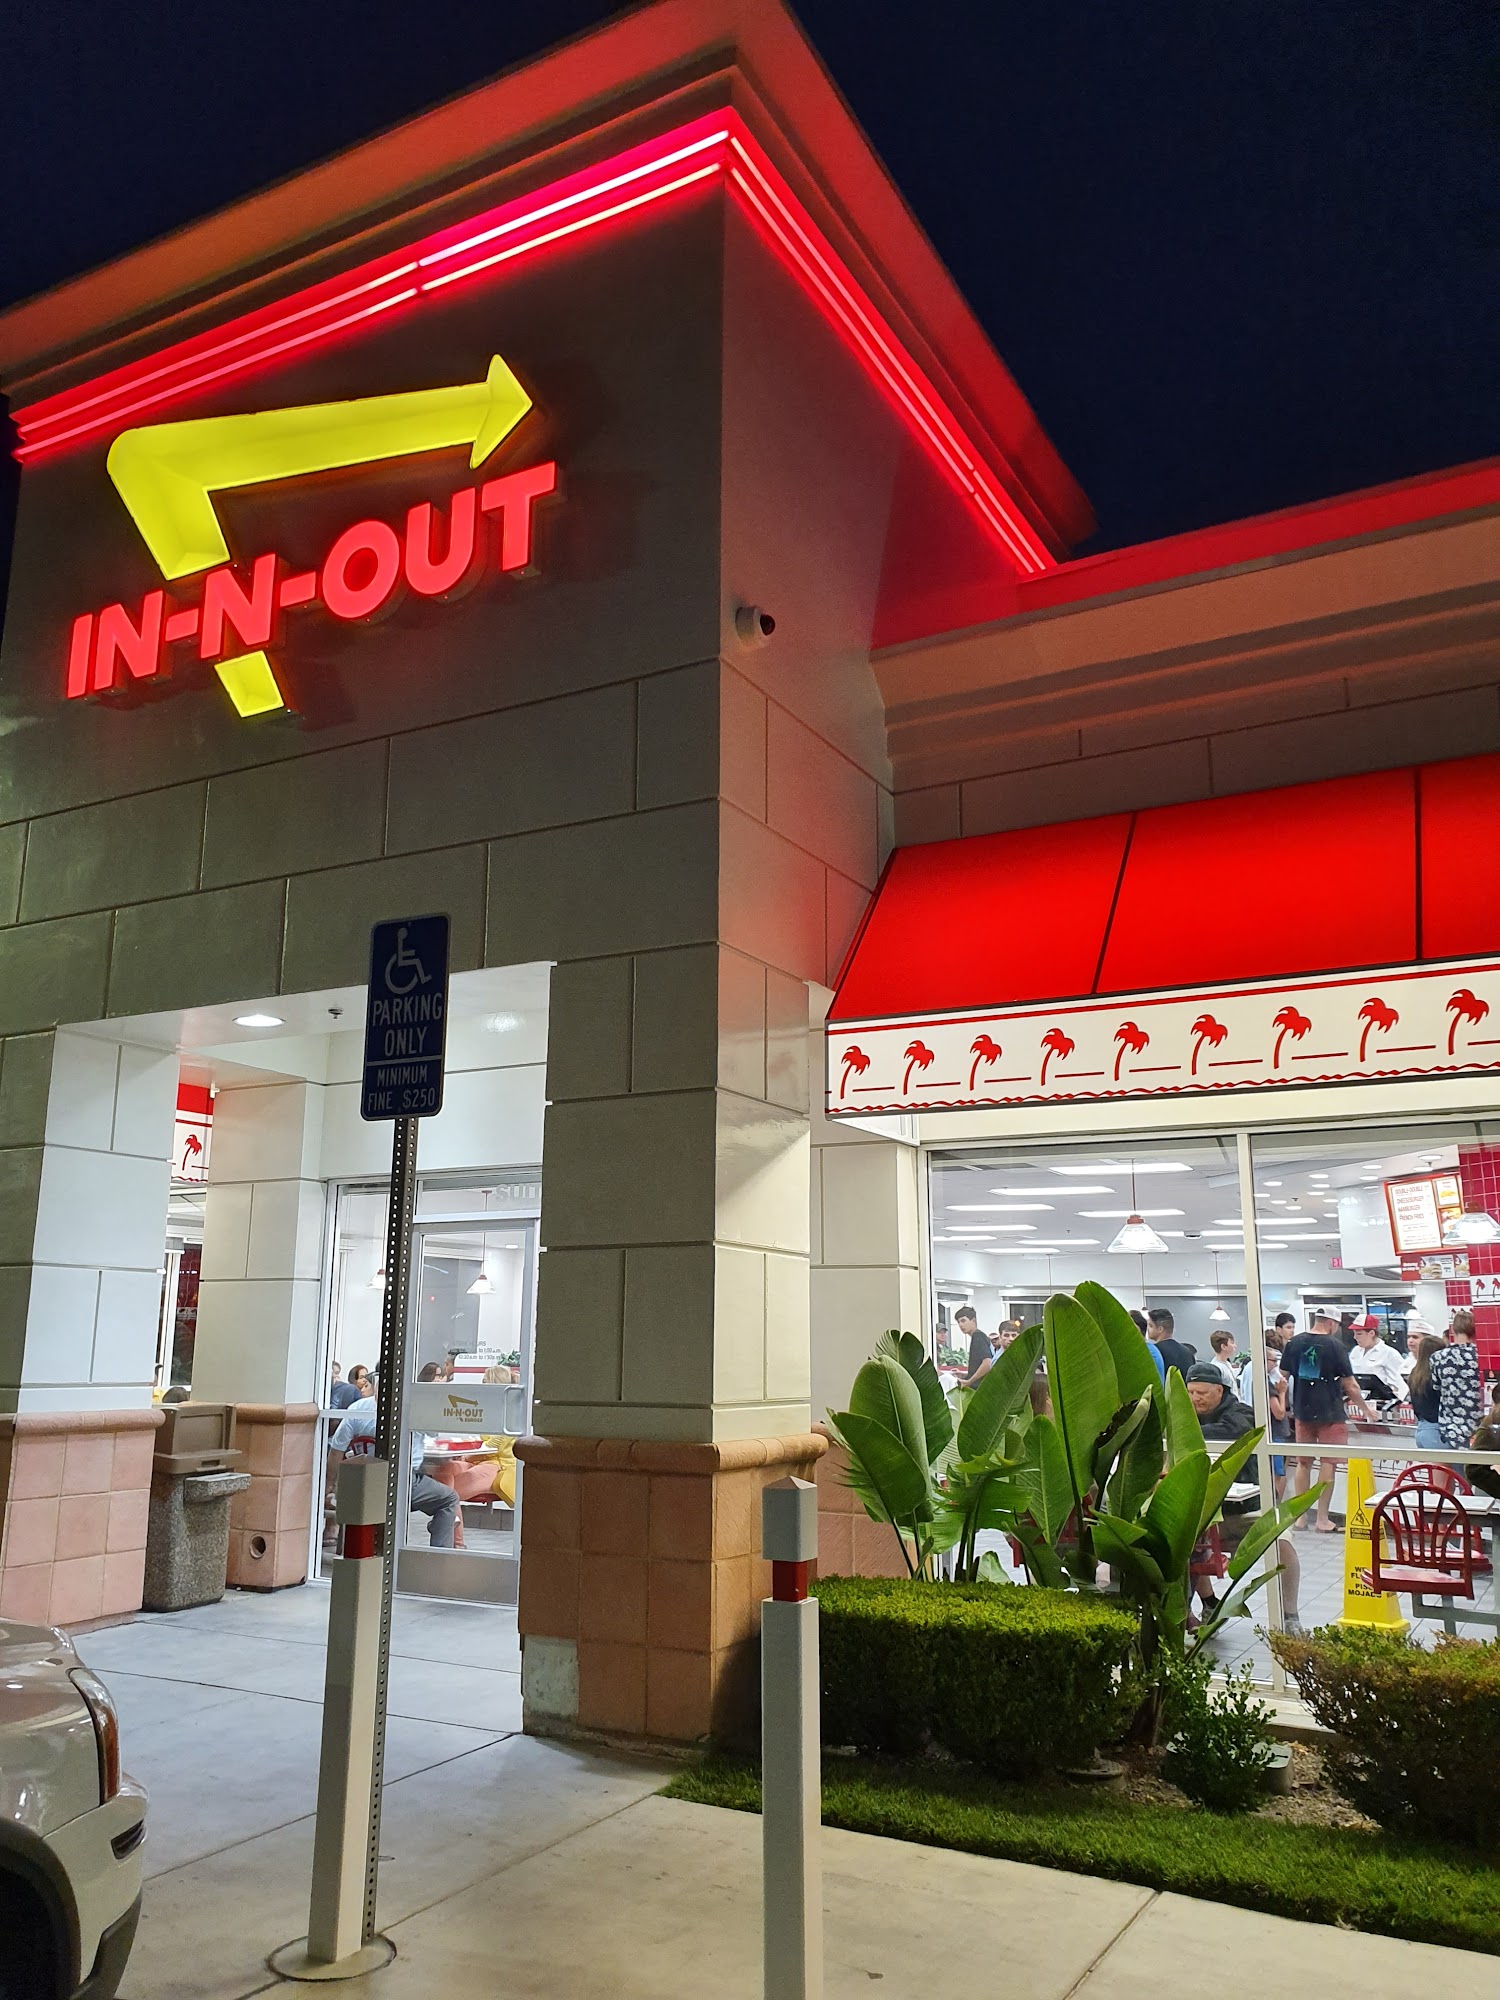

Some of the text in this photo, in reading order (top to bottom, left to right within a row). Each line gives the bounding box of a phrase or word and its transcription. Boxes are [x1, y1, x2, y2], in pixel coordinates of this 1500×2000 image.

[66, 460, 556, 699] IN-N-OUT
[373, 993, 442, 1026] PARKING
[385, 1027, 427, 1056] ONLY
[377, 1064, 428, 1087] MINIMUM
[368, 1088, 435, 1112] FINE $250
